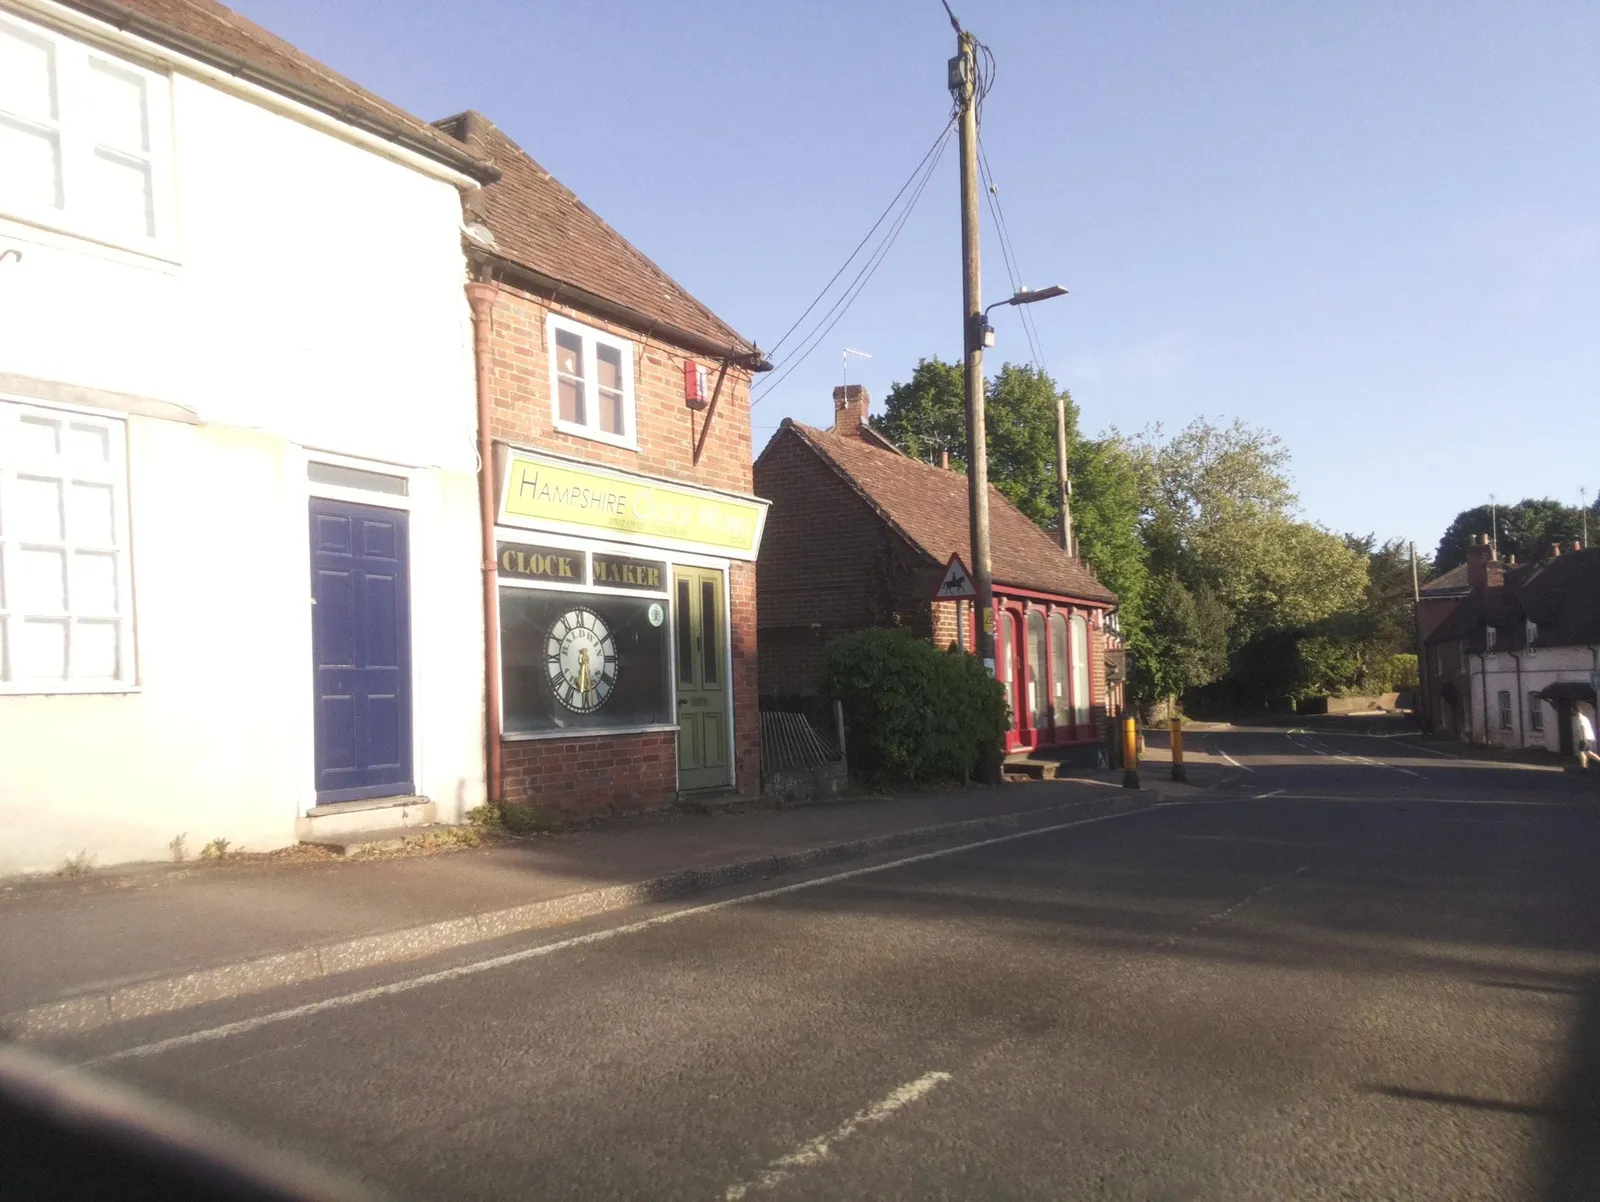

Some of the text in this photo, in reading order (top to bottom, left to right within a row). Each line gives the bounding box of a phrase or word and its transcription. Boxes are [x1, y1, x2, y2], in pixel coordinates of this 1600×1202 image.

[519, 468, 627, 515] HAMPSHIRE
[502, 550, 661, 587] CLOCK MAKER
